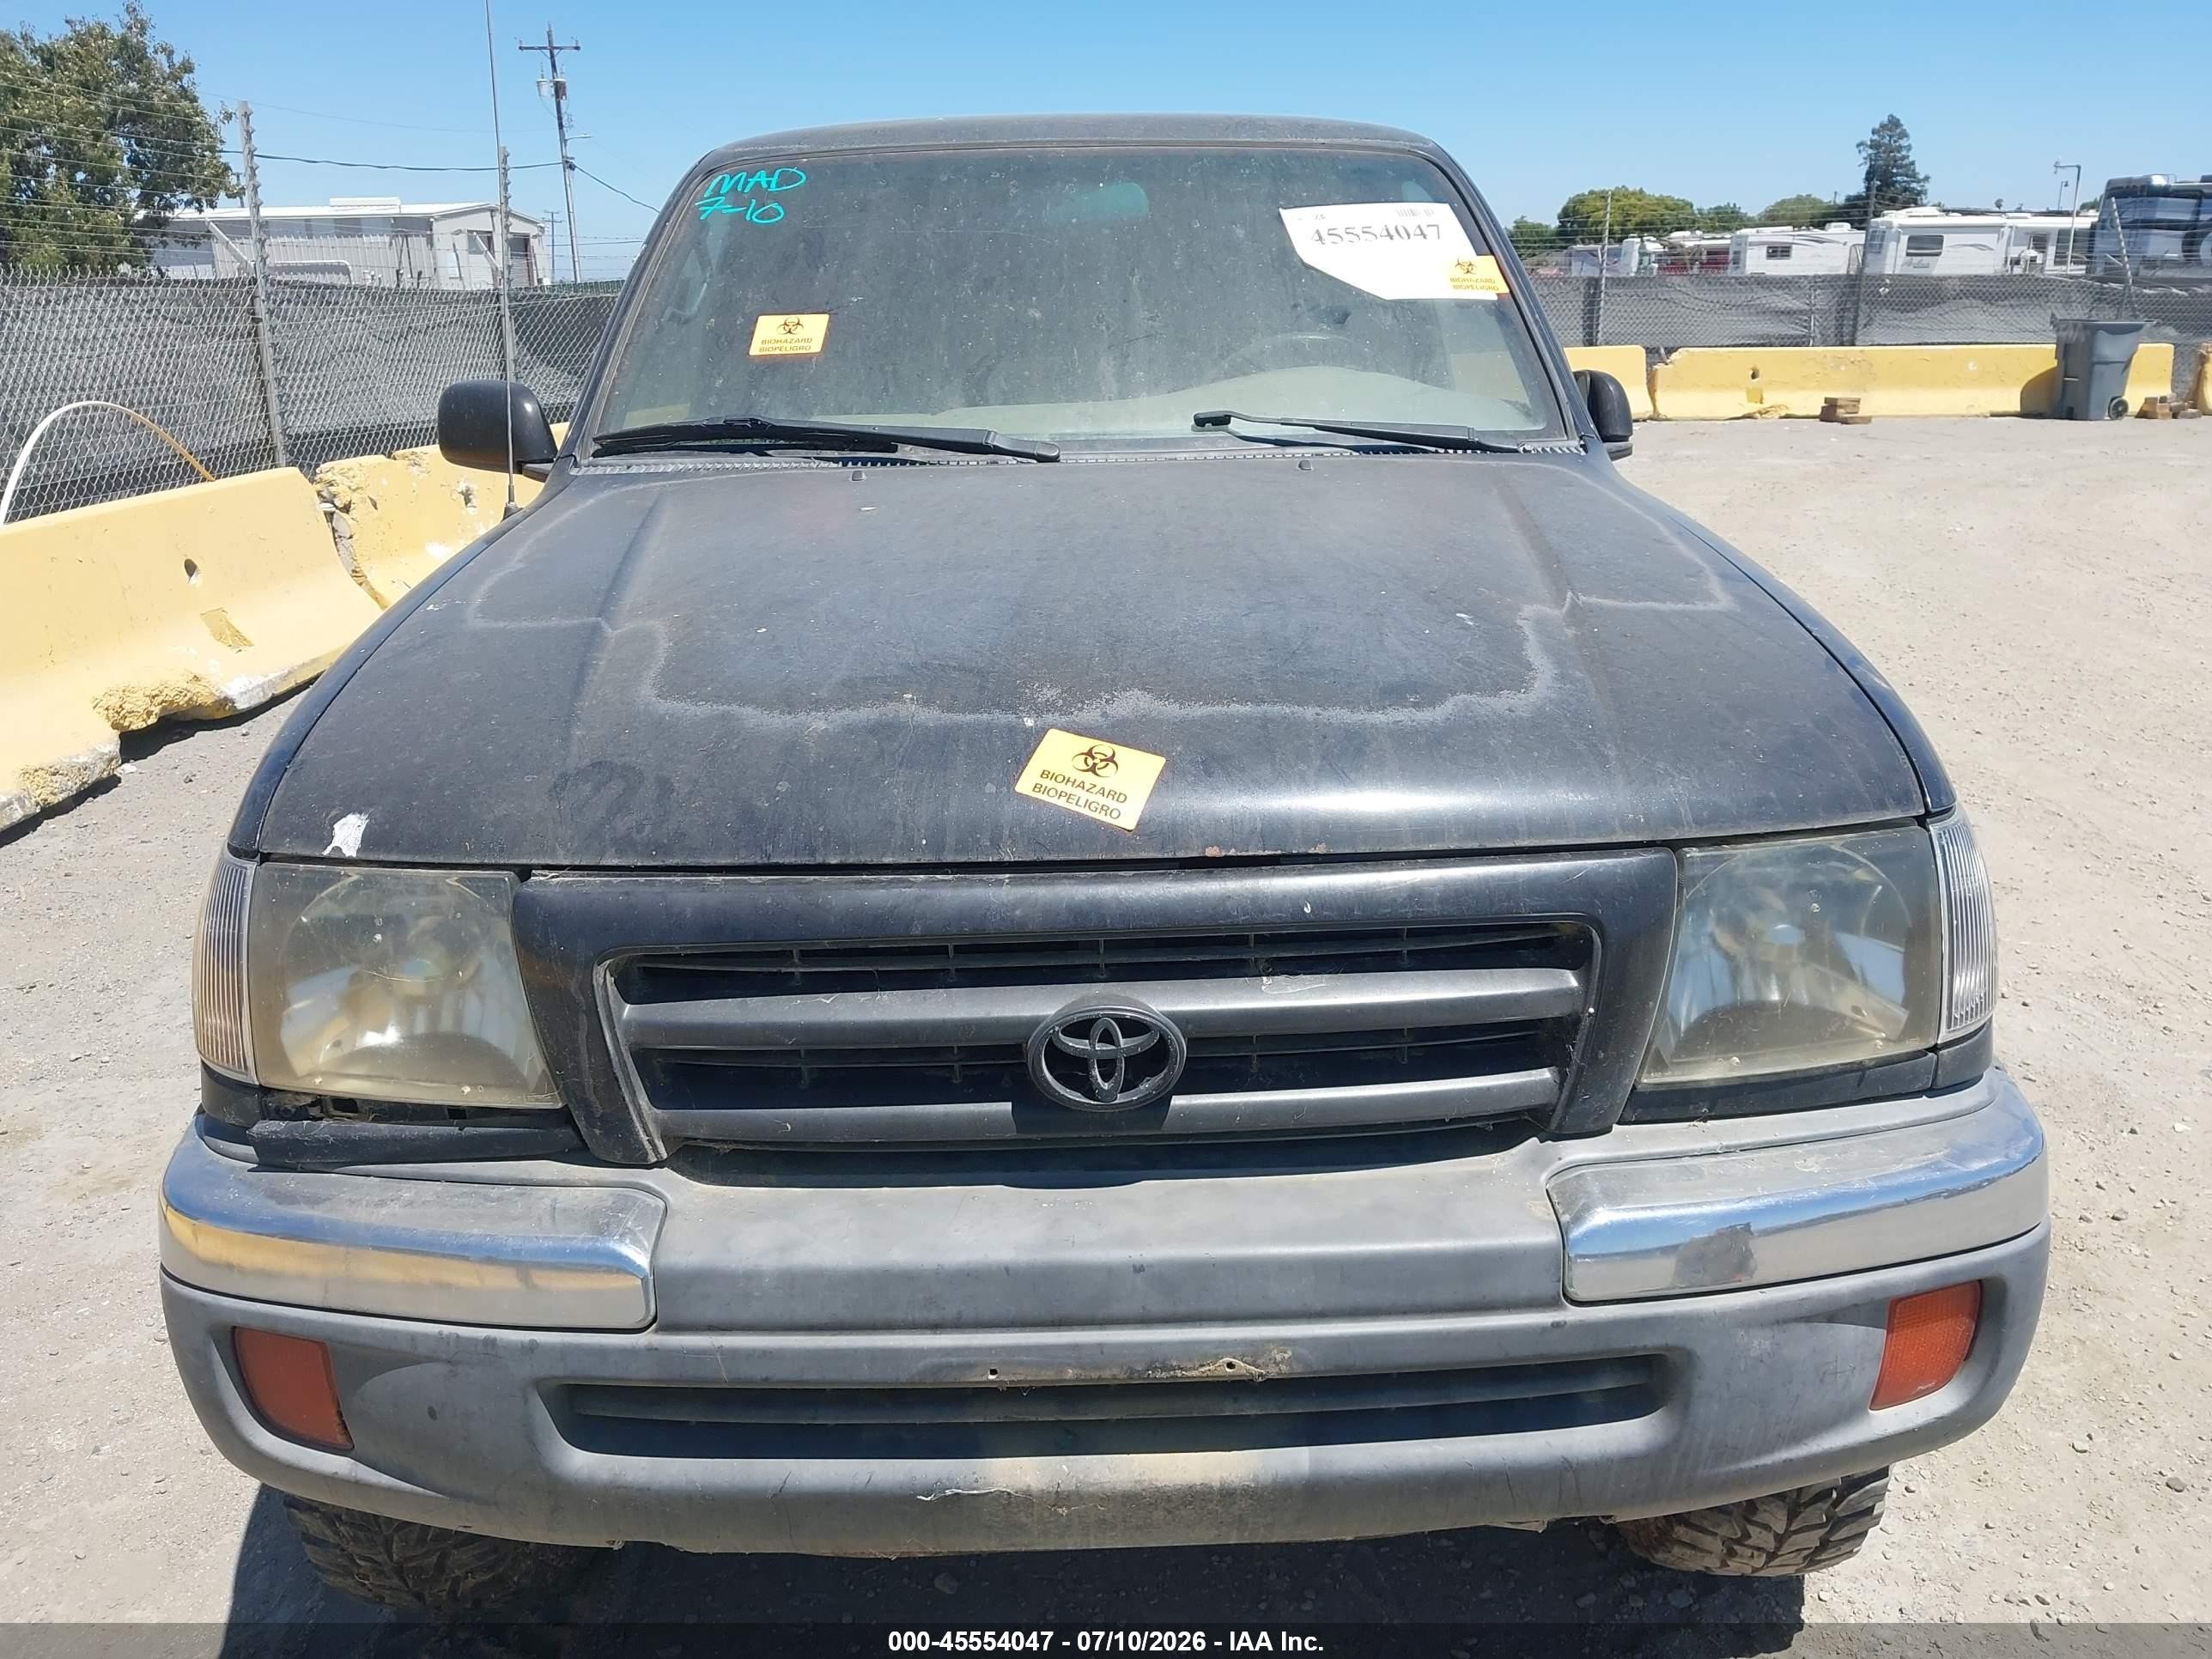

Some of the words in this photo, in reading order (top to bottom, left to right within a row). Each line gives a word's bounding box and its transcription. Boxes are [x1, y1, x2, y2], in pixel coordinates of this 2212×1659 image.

[704, 167, 807, 198] MAD
[695, 196, 785, 224] 7-10
[1311, 223, 1441, 246] 45554047
[1031, 782, 1121, 820] BIOPELIGRO
[1039, 769, 1127, 804] BIOHAZARD
